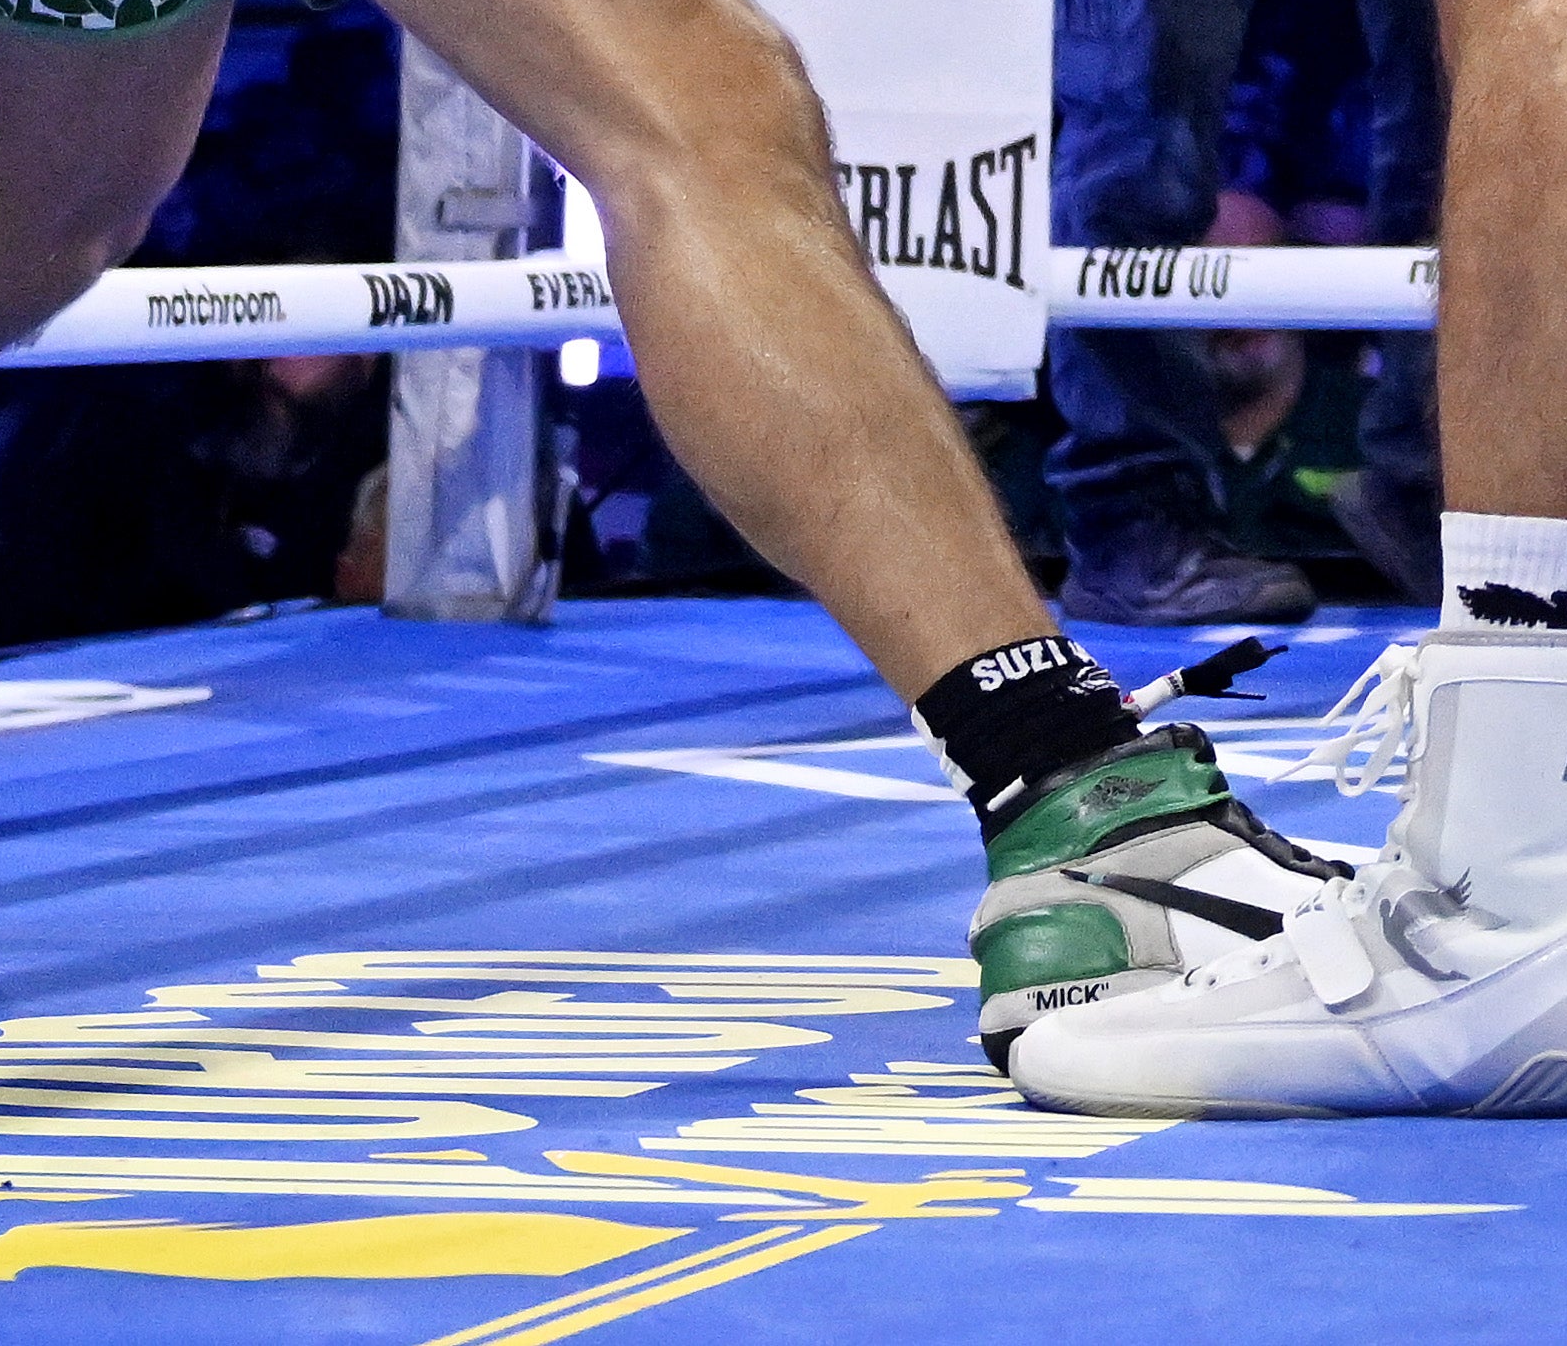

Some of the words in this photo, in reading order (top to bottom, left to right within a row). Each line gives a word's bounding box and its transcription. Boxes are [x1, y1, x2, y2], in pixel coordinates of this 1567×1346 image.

[147, 283, 287, 329] matchroom.
[361, 272, 456, 329] DAZN
[526, 269, 614, 311] EVERL
[970, 639, 1068, 692] SUZI
